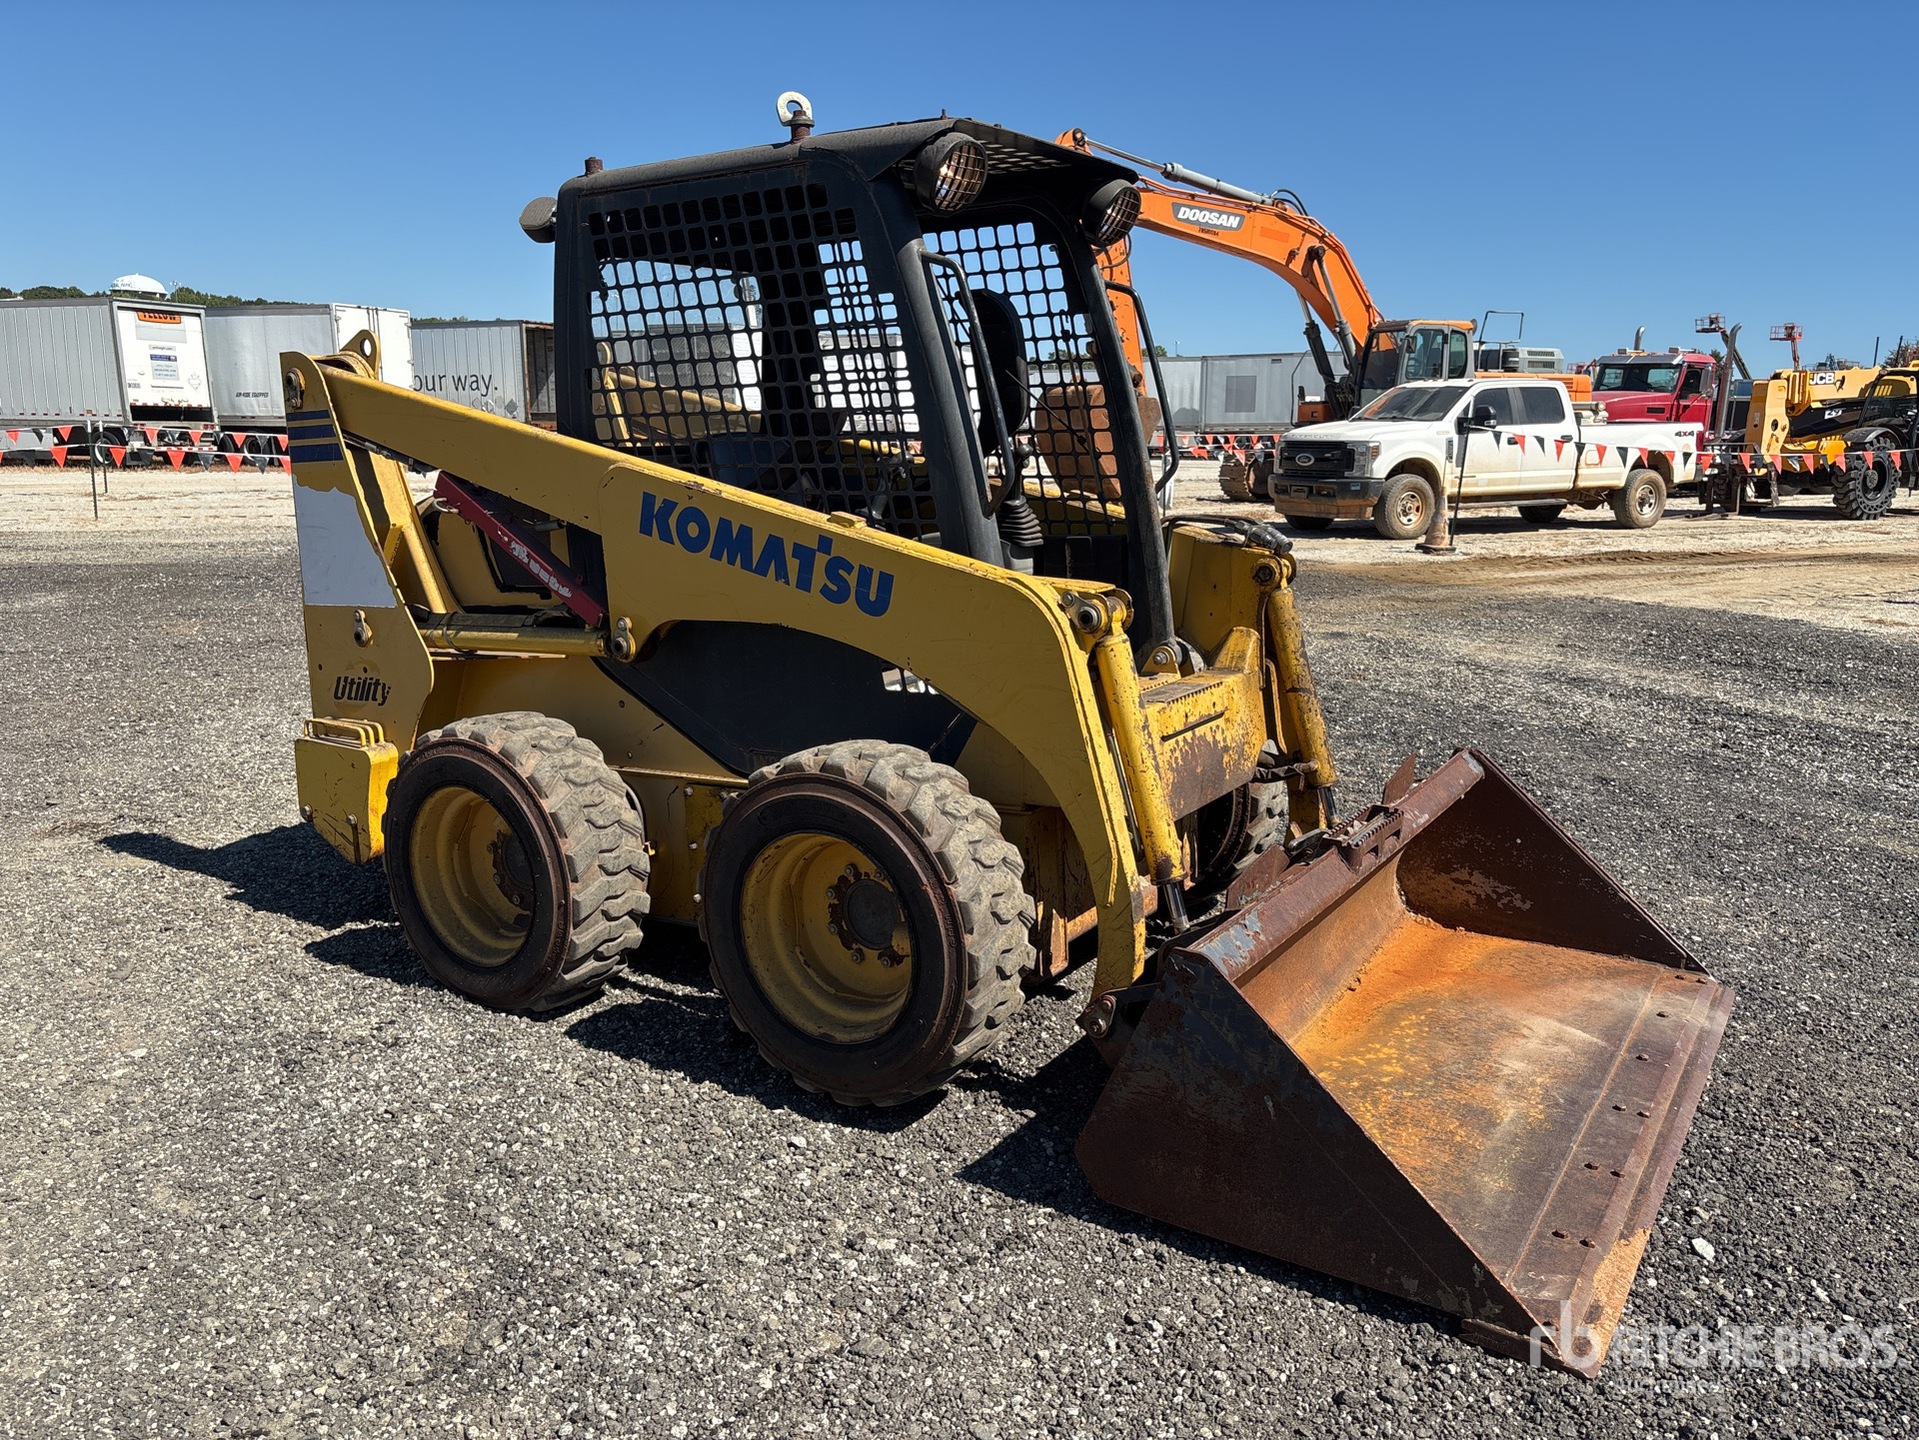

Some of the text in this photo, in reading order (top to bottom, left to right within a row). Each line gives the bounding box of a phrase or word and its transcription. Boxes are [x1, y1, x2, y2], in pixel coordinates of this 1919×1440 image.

[1178, 206, 1240, 228] DOOSAN
[452, 374, 498, 397] way.
[1809, 372, 1835, 385] JCB
[639, 491, 895, 618] KOMATSU
[333, 676, 391, 706] Utility
